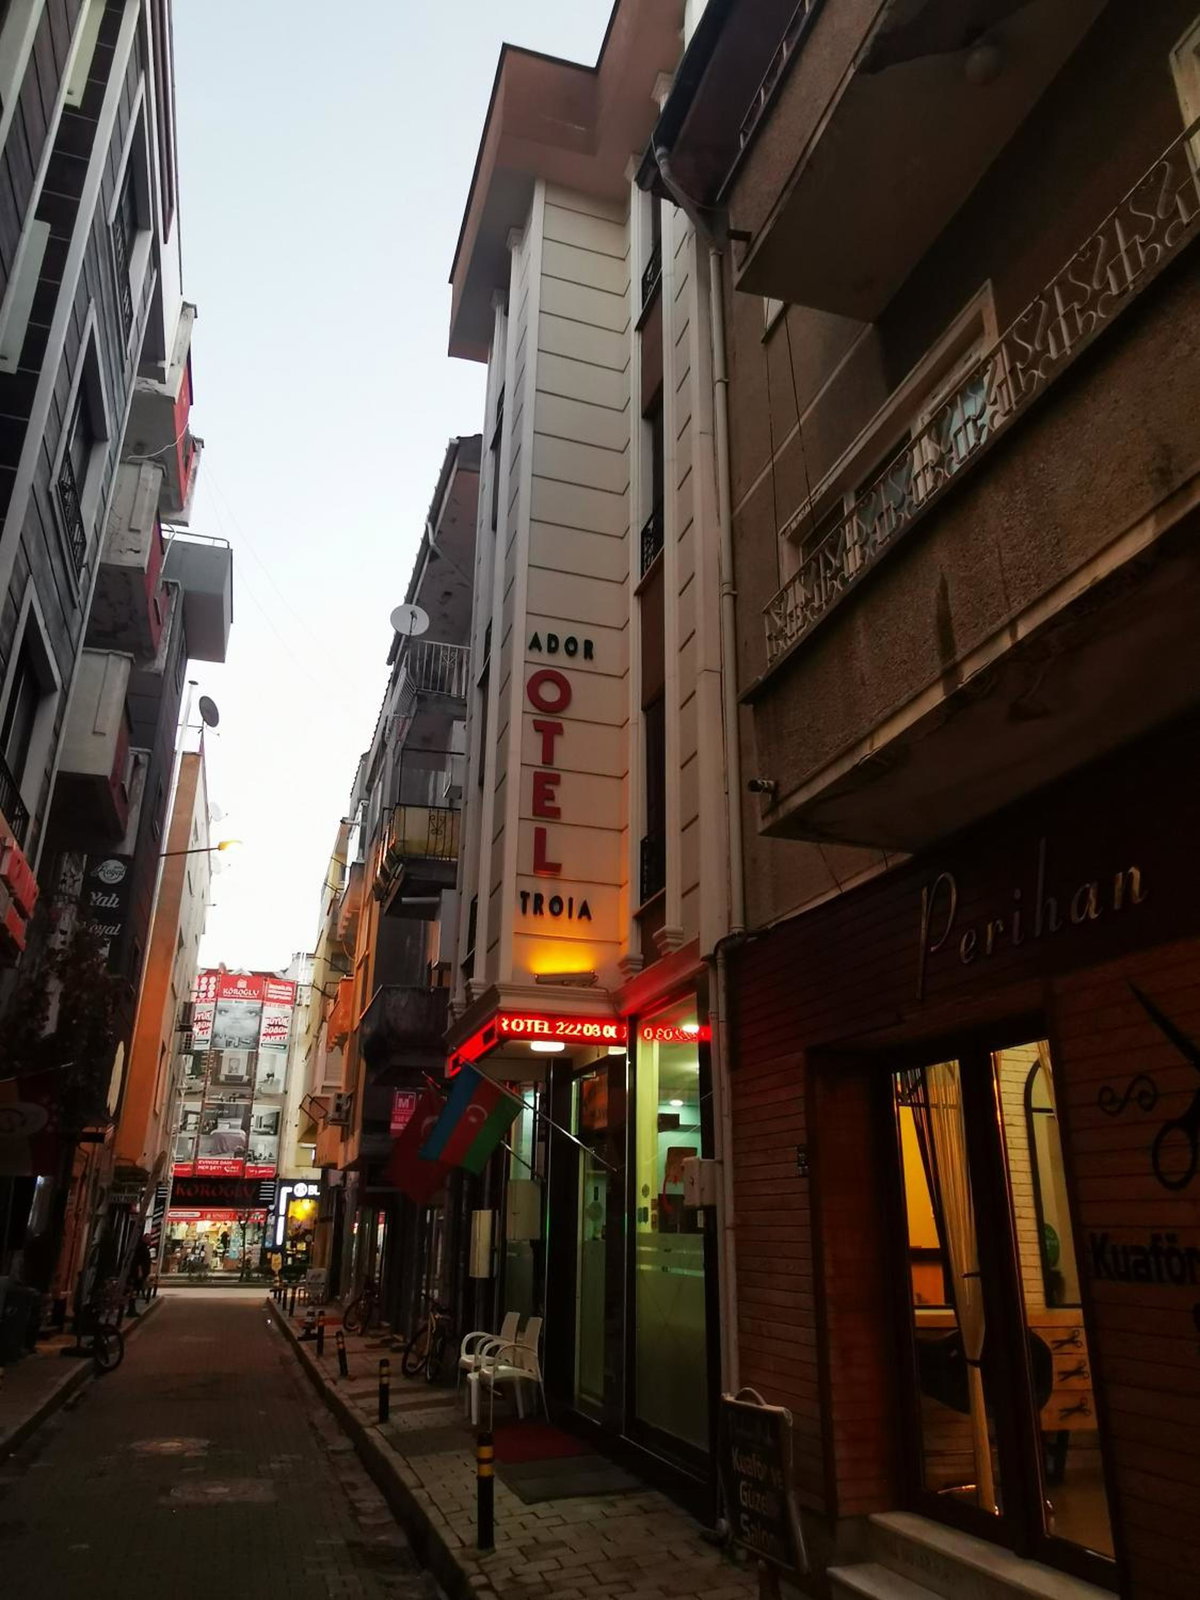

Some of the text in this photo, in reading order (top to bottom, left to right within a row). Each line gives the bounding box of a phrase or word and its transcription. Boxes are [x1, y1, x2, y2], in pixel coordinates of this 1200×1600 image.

[528, 632, 594, 660] ADOR
[526, 669, 572, 877] OTEL
[520, 891, 592, 921] TROIA
[915, 835, 1152, 1000] Perihan
